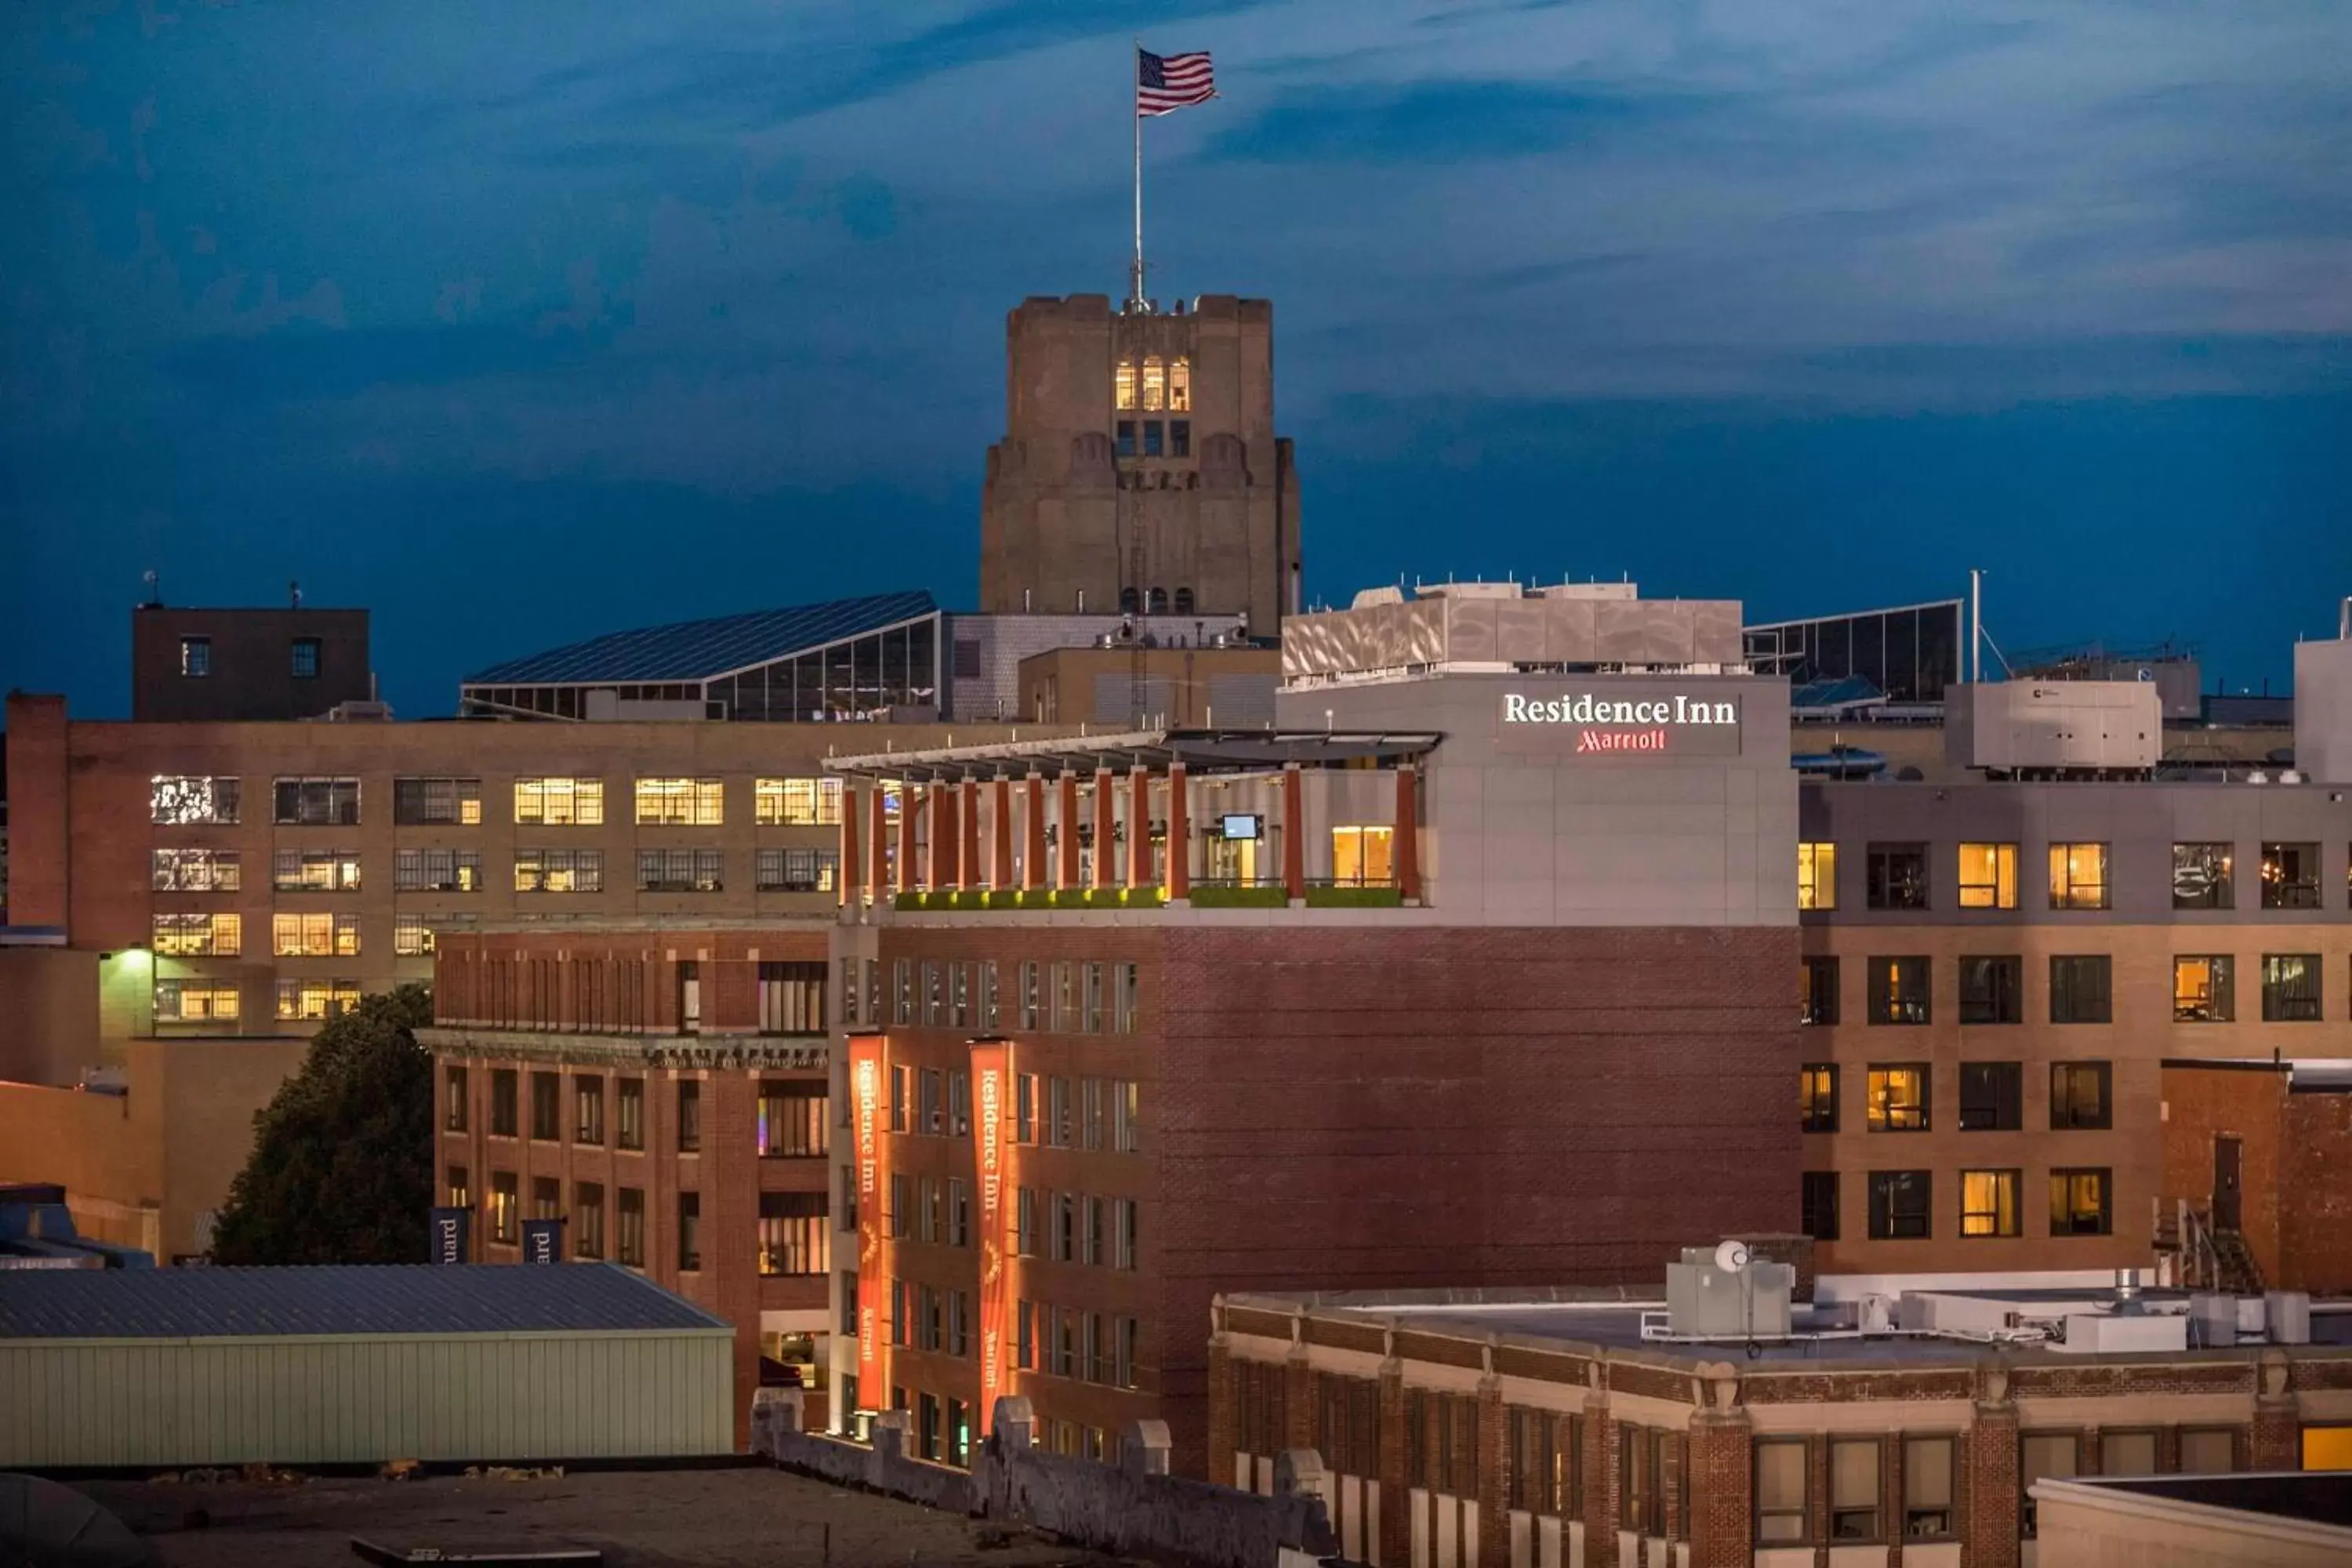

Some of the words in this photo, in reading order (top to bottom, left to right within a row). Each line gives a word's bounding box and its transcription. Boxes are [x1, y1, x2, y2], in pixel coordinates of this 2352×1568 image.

[1504, 694, 1668, 724] Residence
[1675, 695, 1737, 724] Inn
[1577, 729, 1665, 753] Marriott
[860, 1059, 875, 1156] Residence
[982, 1069, 999, 1170] Residence
[862, 1159, 876, 1192] Inn
[985, 1174, 1001, 1210] Inn
[862, 1305, 874, 1361] Marriott
[984, 1327, 997, 1387] Marriott
